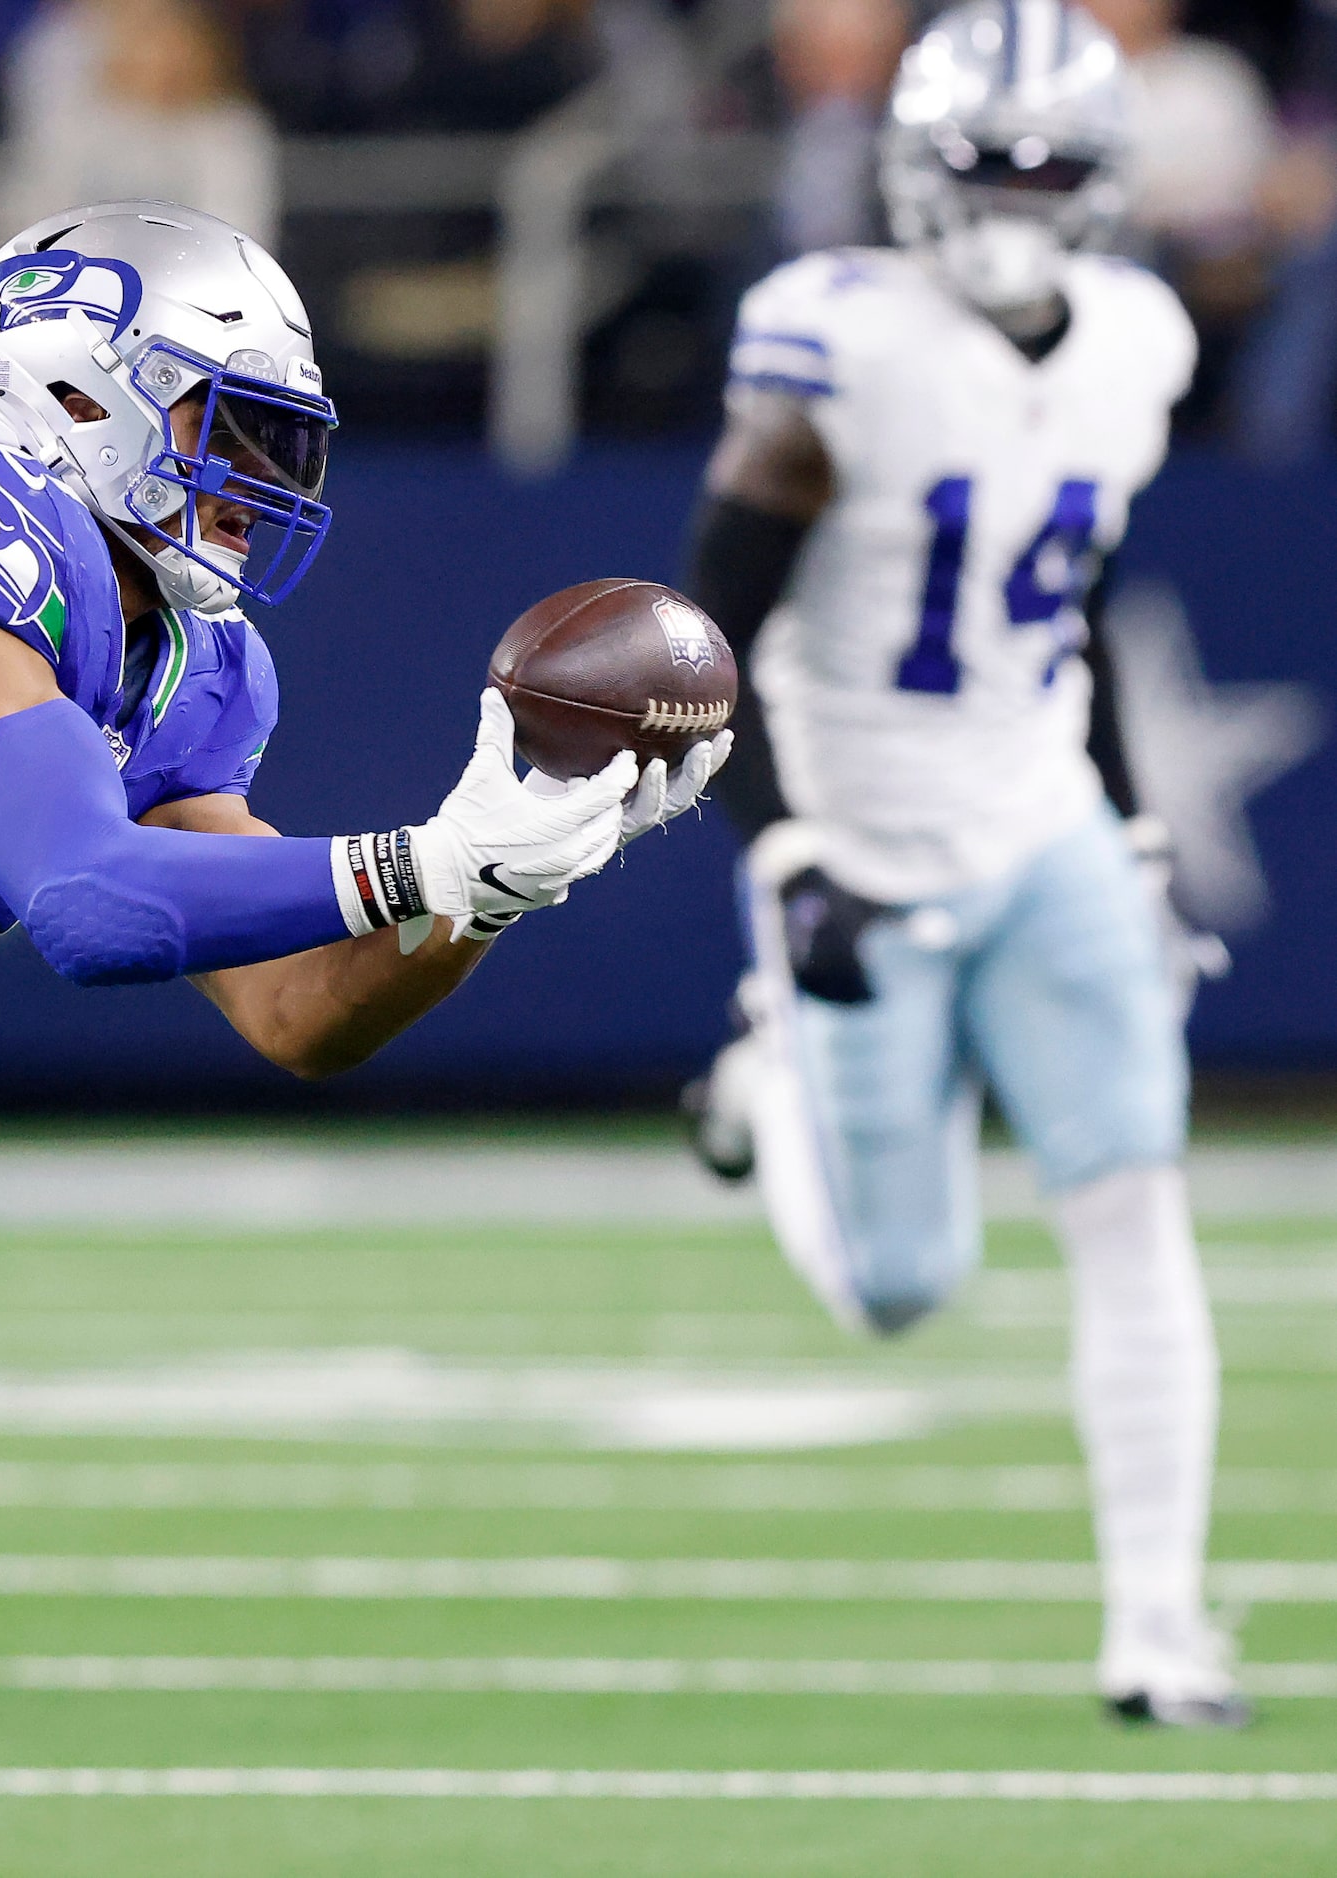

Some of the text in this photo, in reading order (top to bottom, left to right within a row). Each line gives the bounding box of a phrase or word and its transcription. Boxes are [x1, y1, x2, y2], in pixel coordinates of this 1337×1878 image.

[896, 477, 1099, 692] 14
[348, 842, 364, 871] YOUR
[379, 861, 402, 905] History
